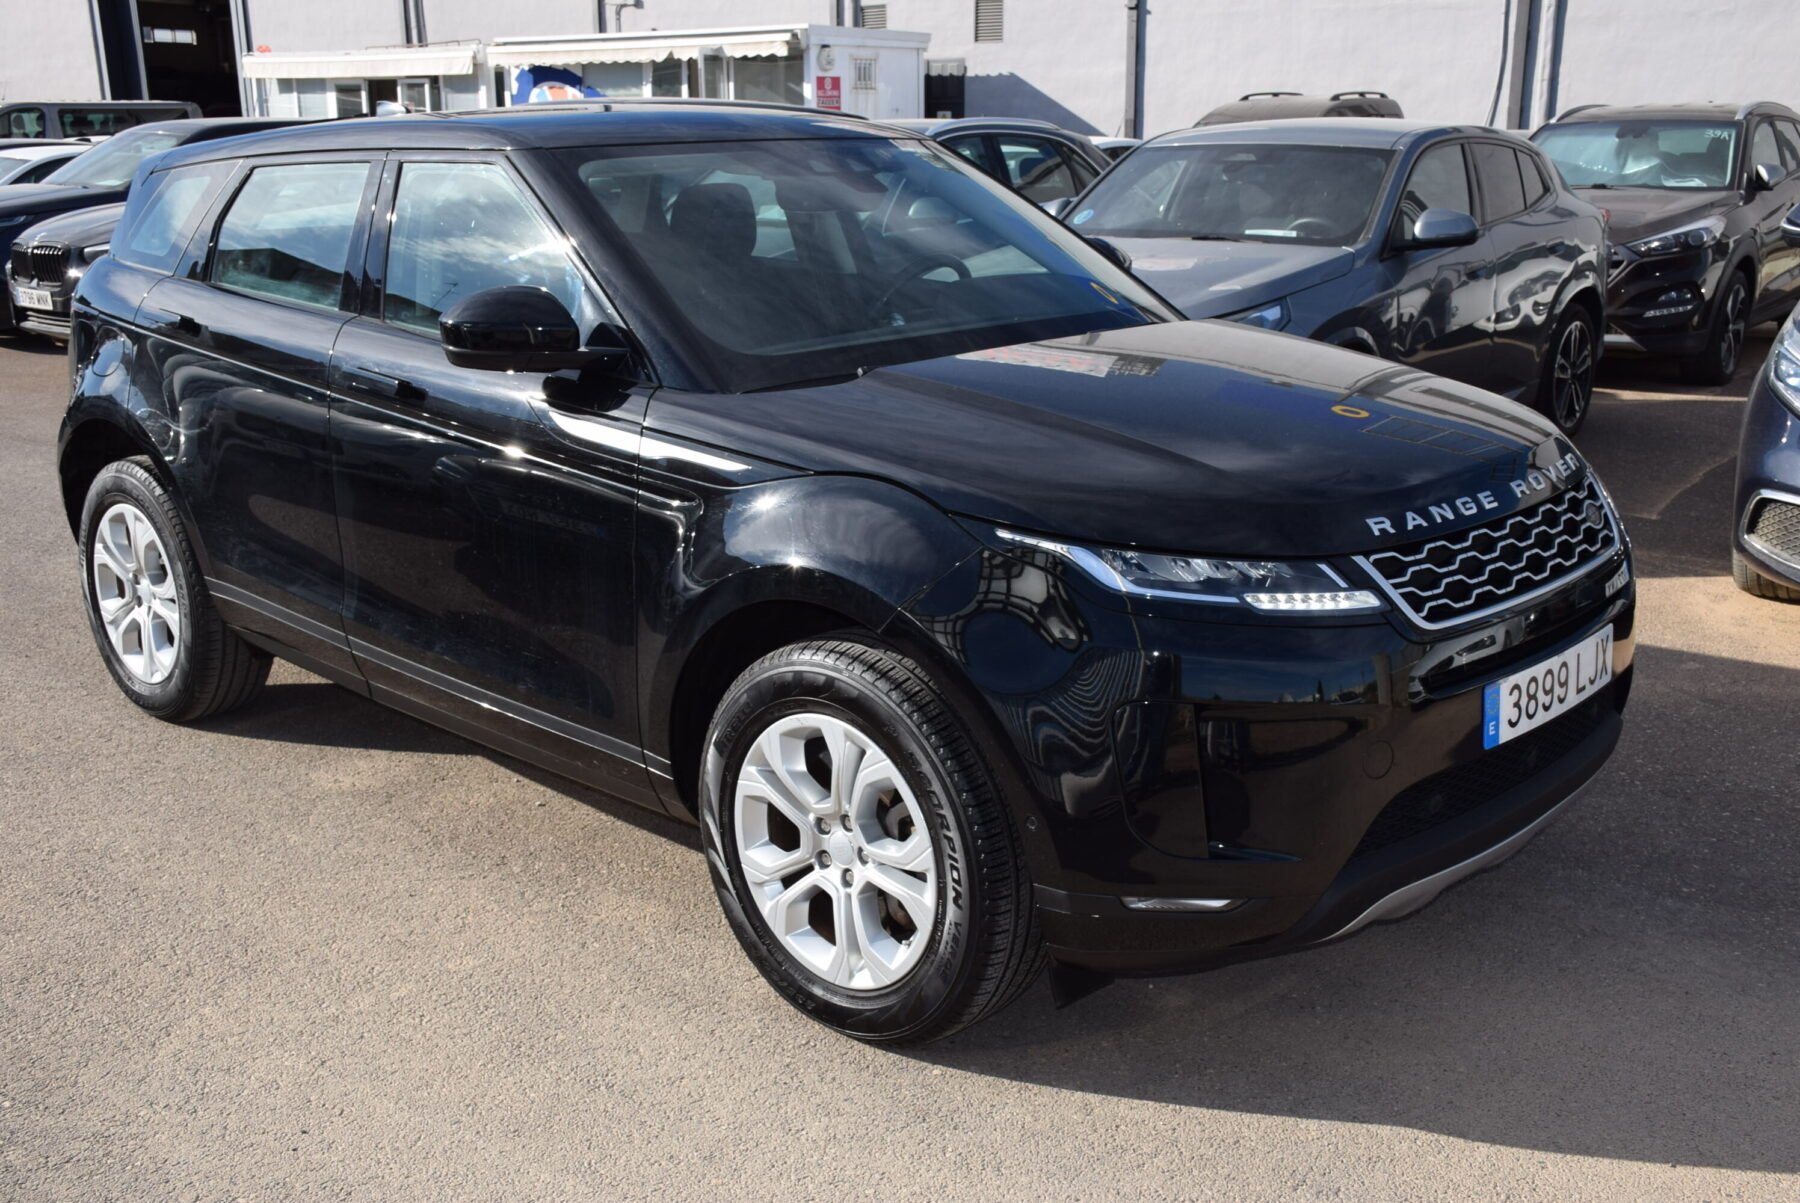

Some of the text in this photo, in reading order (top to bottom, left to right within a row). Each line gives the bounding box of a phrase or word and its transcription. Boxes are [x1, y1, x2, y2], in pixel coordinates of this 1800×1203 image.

[1365, 452, 1581, 536] RANGE ROVER
[1507, 634, 1610, 729] 3899 LJX
[1489, 720, 1497, 736] E
[907, 751, 964, 912] SCORPION
